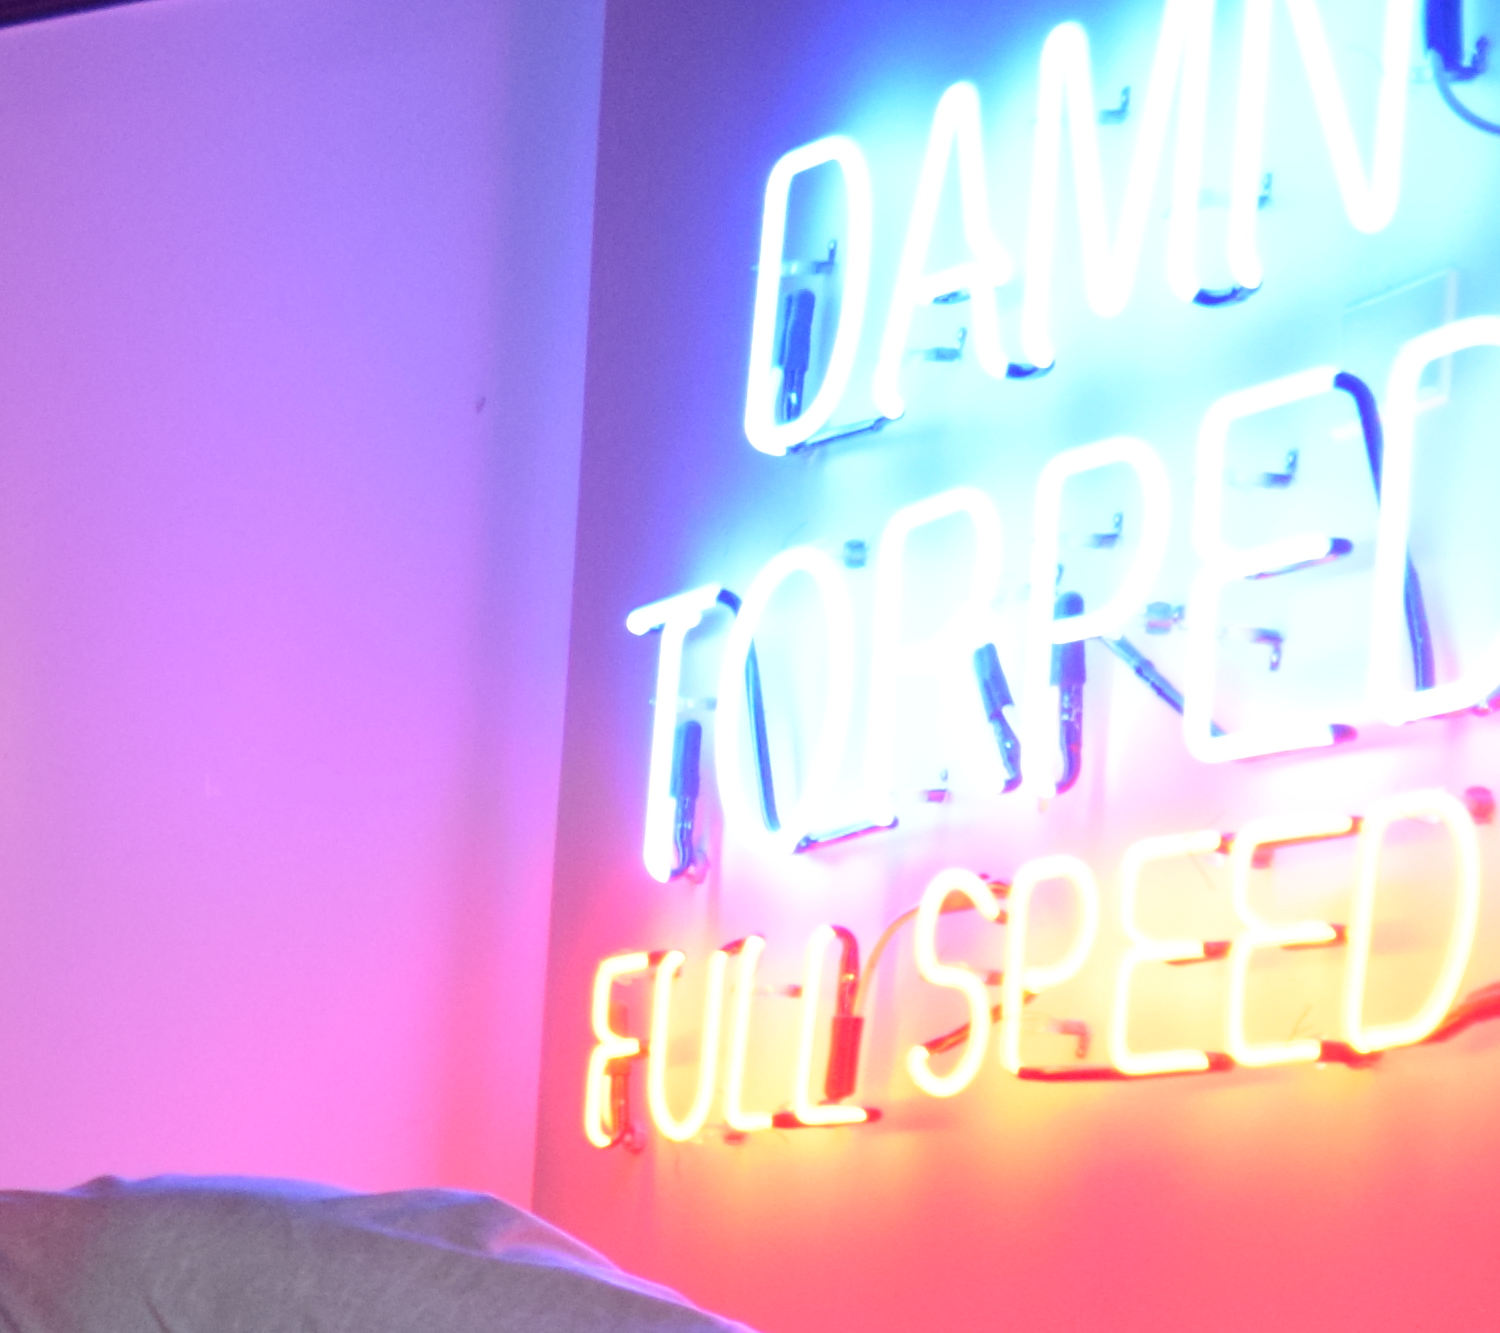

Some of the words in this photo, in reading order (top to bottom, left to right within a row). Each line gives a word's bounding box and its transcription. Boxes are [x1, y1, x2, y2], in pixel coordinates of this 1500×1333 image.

[744, 0, 1412, 456] DAMN
[585, 923, 872, 1147] FULL
[906, 789, 1481, 1097] SPEED
